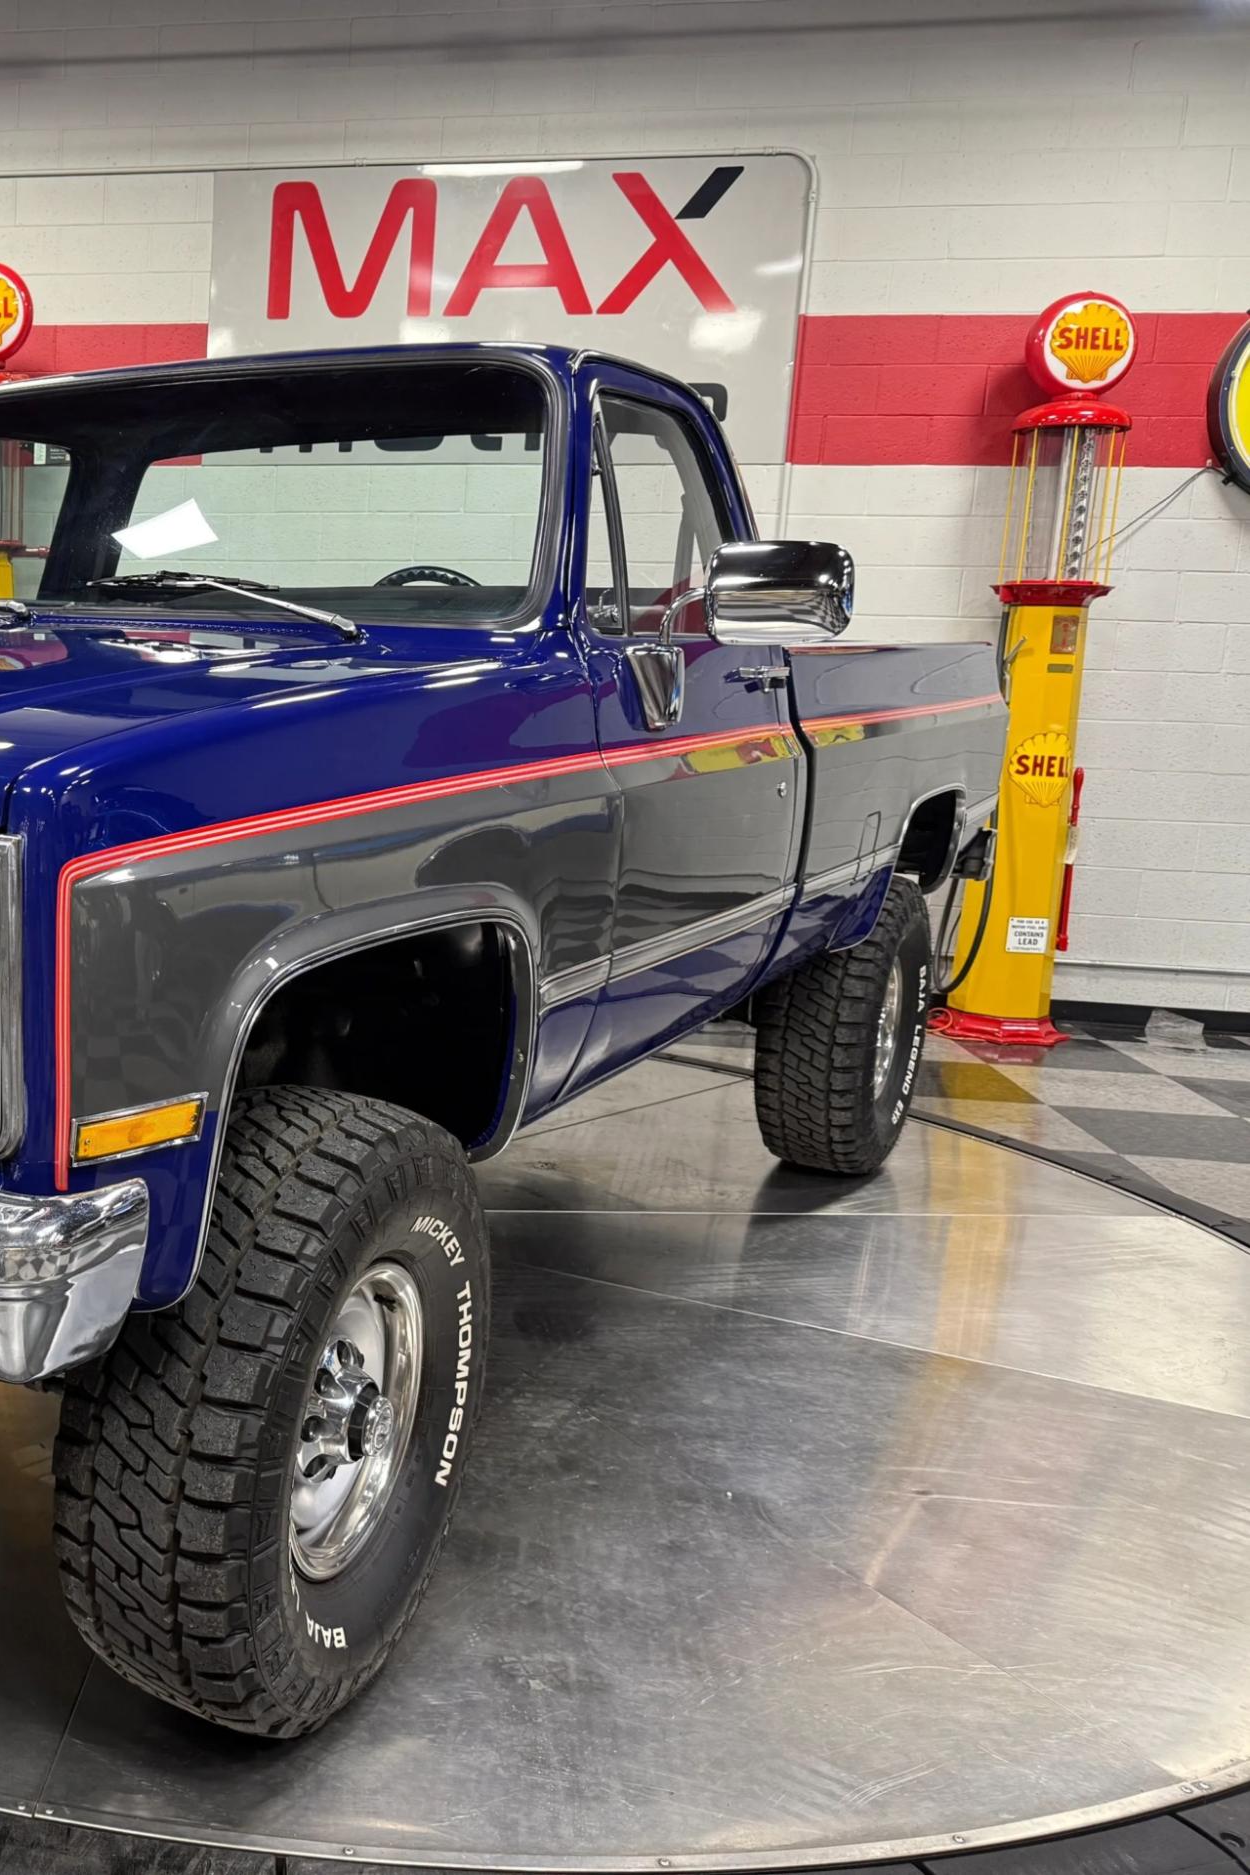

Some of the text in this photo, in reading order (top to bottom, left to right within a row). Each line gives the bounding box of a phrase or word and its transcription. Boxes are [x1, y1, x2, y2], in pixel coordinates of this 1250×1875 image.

[266, 166, 744, 320] MAX
[1056, 326, 1124, 351] SHELL
[1017, 938, 1039, 946] LEAD
[917, 964, 927, 1013] BAJA
[902, 1024, 923, 1096] LEGEND
[410, 1216, 472, 1487] MICKEY THOMPSON
[305, 1611, 347, 1649] BAJA
